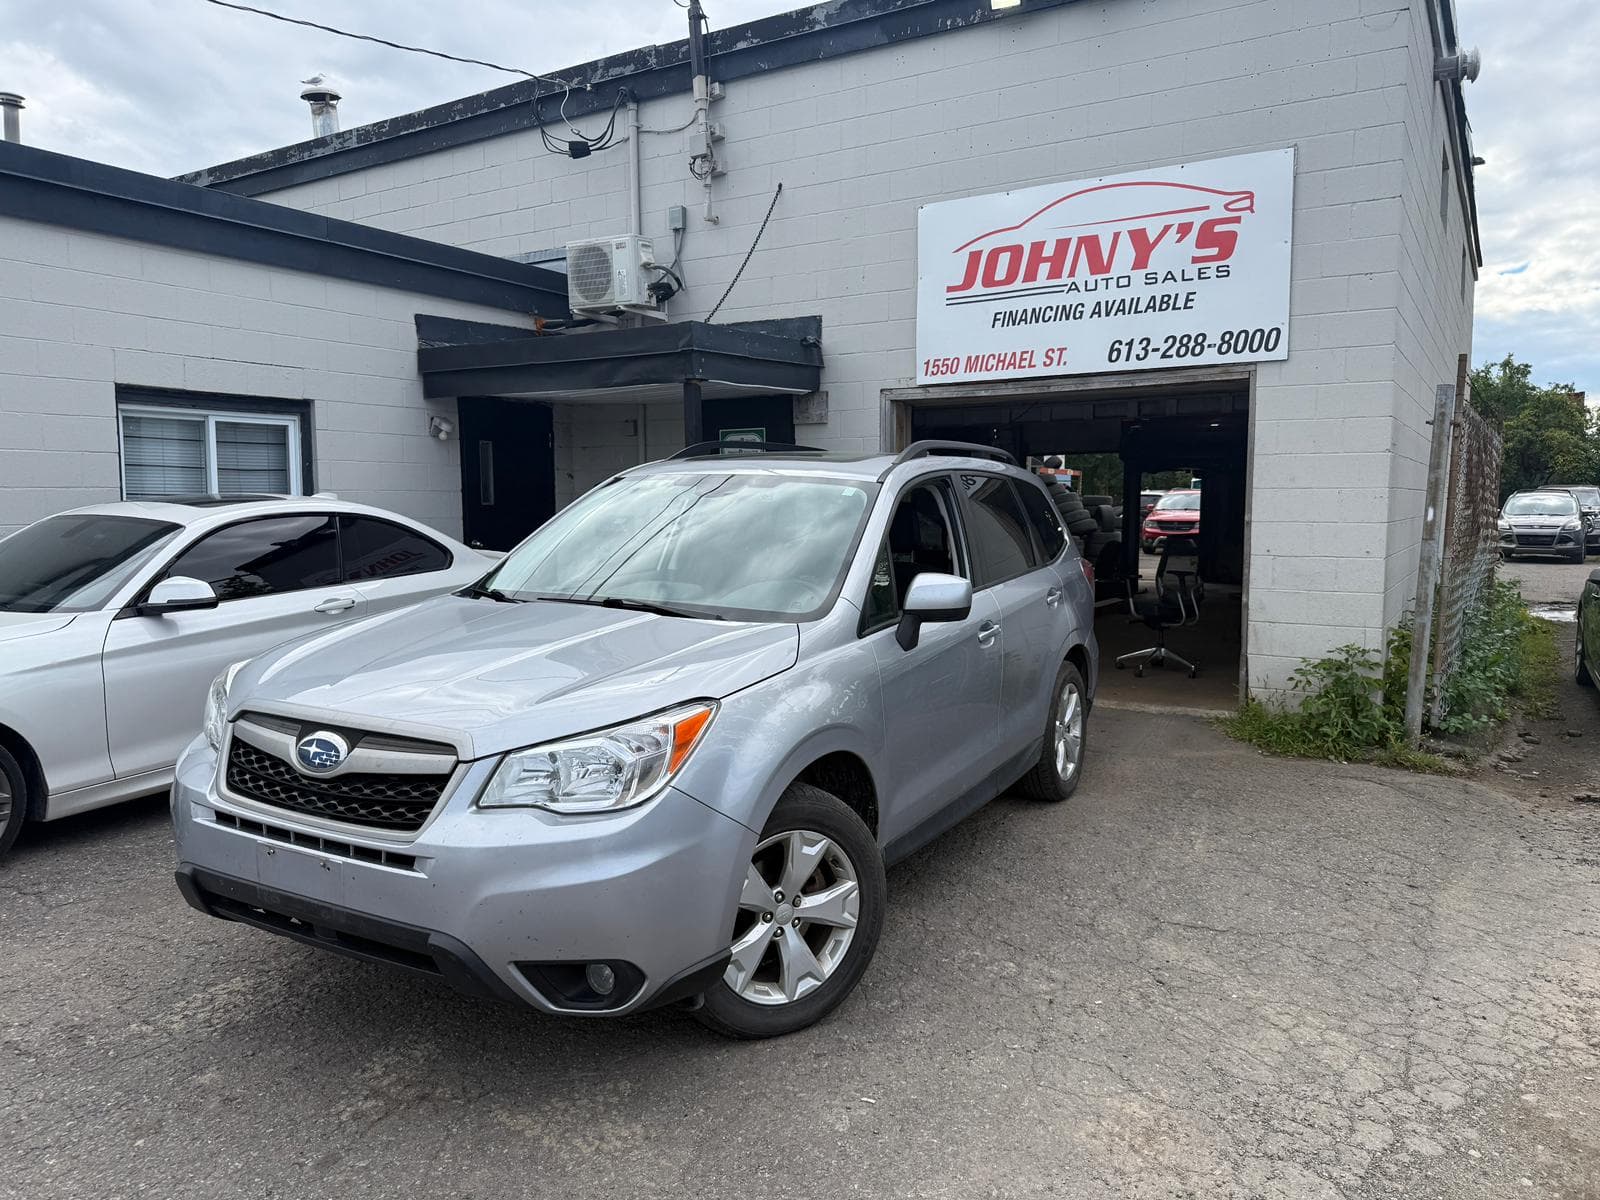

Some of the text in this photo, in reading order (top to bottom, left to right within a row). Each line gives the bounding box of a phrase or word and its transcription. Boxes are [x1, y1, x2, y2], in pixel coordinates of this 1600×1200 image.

[946, 215, 1242, 293] JOHNY'S
[1066, 264, 1231, 294] AUTO SALES
[992, 291, 1197, 329] FINANCING AVAILABLE
[923, 347, 1067, 377] 1550 MICHAEL ST.
[1107, 327, 1282, 363] 613-288-8000
